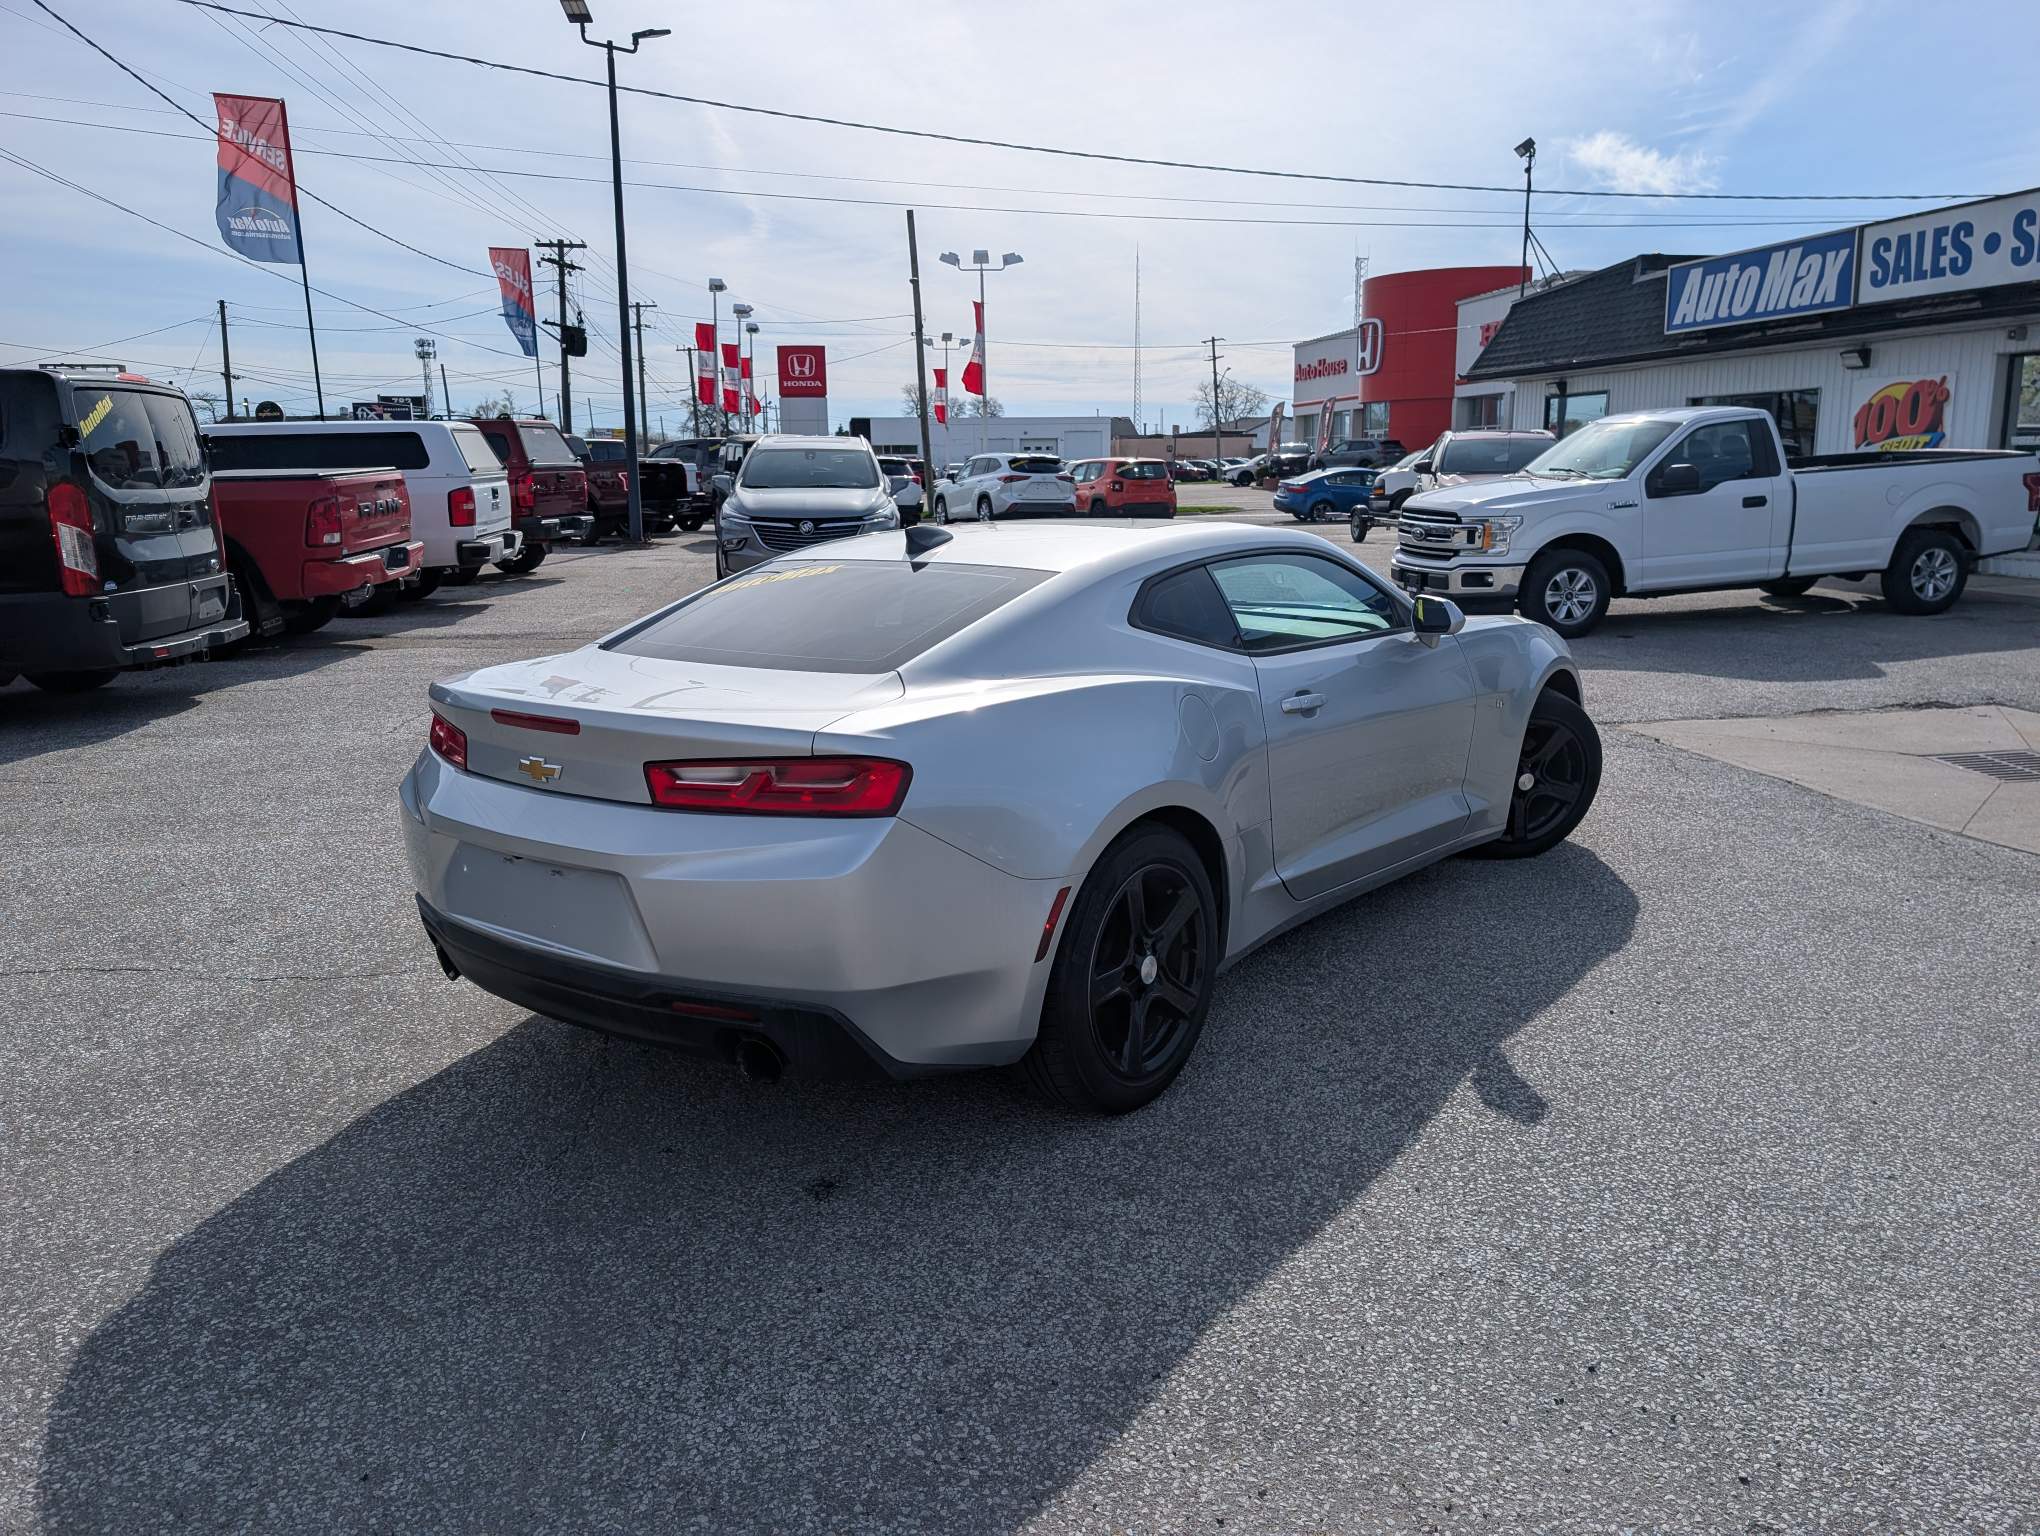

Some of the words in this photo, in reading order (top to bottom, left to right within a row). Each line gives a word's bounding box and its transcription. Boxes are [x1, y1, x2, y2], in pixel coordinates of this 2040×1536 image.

[1870, 221, 1974, 288] SALES
[2010, 208, 2040, 267] S
[1672, 247, 1850, 326] AutoMax
[79, 394, 114, 438] AutoMax
[358, 497, 402, 517] RAM
